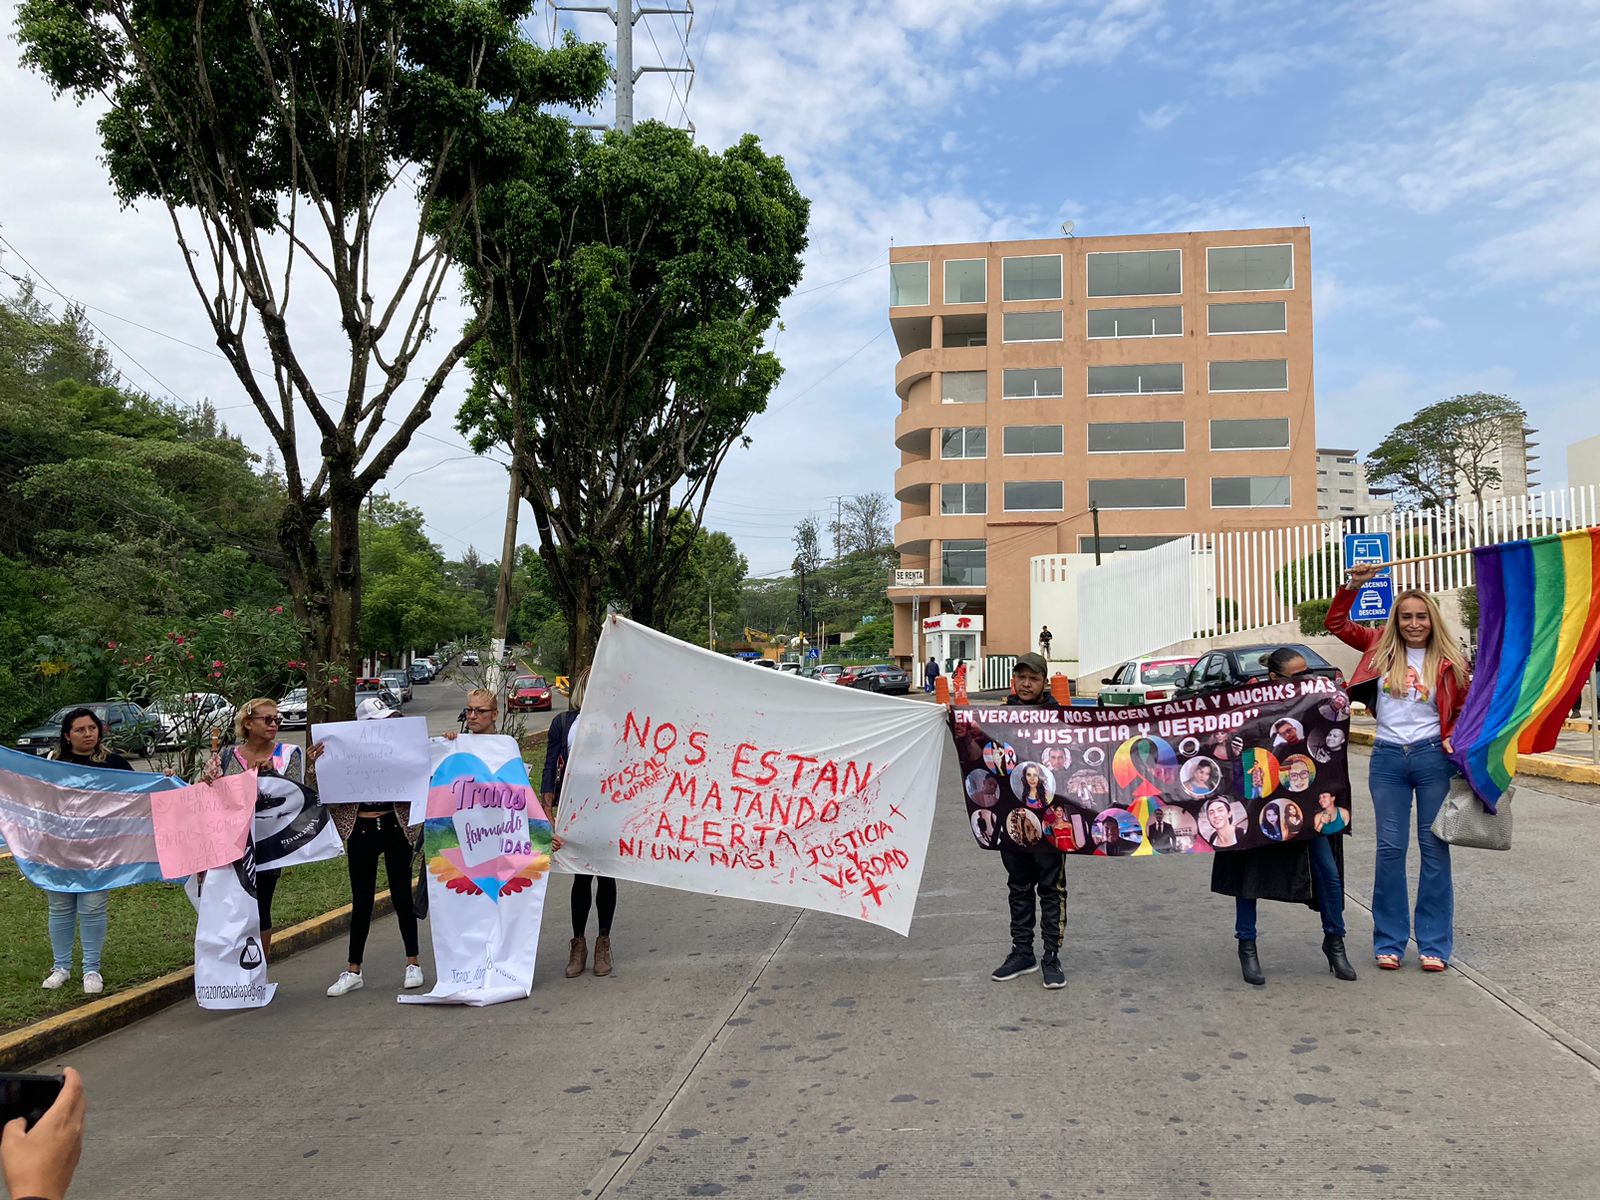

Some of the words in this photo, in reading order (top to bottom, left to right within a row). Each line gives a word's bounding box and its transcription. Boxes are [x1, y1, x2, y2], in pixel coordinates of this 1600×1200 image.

[897, 571, 904, 580] SE
[905, 571, 923, 580] RENTA
[1359, 608, 1386, 616] DESCENSO
[954, 709, 973, 723] EN
[979, 709, 1059, 724] VERACRUZ
[1064, 711, 1092, 723] NOS
[1095, 708, 1150, 722] HACEN
[1153, 697, 1207, 716] FALTA
[1210, 694, 1221, 709] Y
[1227, 683, 1296, 706] MUCHXS
[1138, 722, 1151, 738] Y
[623, 711, 709, 766] NOS
[731, 743, 873, 797] ESTAN
[450, 776, 527, 811] Trans
[663, 771, 840, 830] MATANDO
[281, 818, 320, 846] Tolerancia
[619, 837, 643, 859] NI
[651, 843, 700, 863] UNX
[655, 811, 801, 859] ALERTA
[807, 820, 894, 868] JUSTICIA
[819, 848, 910, 889] VERDAD
